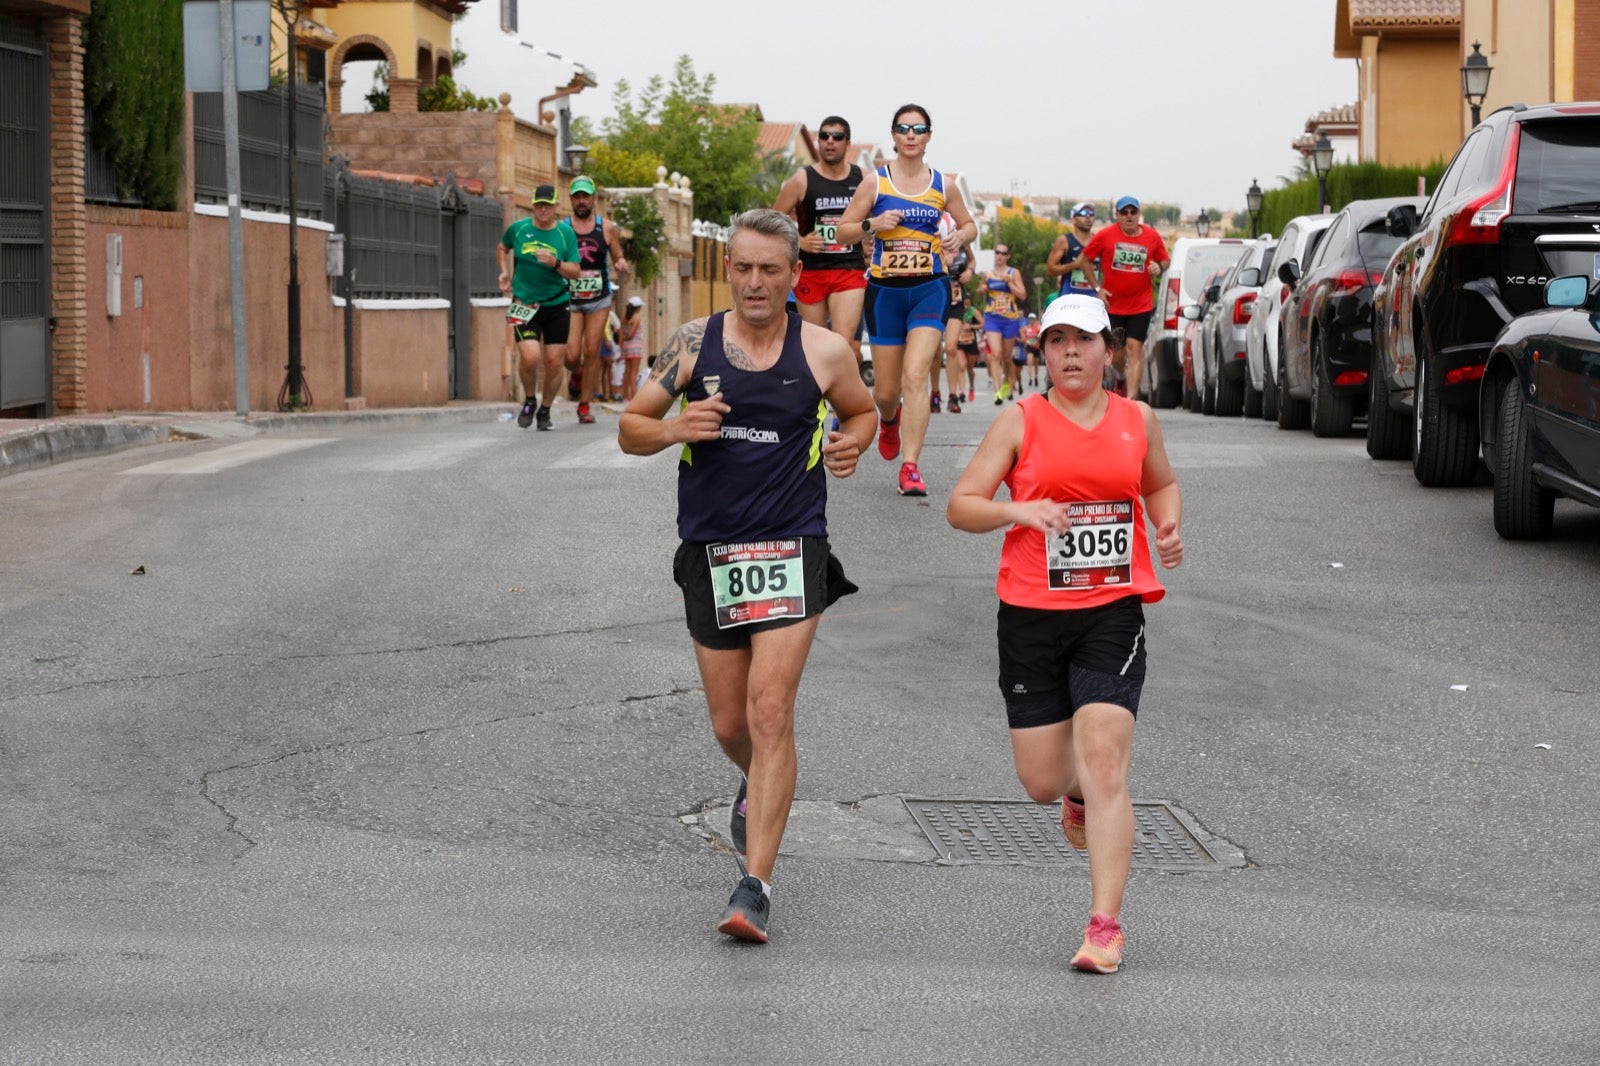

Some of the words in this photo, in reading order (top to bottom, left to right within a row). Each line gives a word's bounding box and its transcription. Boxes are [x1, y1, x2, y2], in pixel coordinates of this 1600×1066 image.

[818, 227, 836, 241] 10
[888, 254, 930, 269] 2212
[576, 279, 597, 290] 272
[1084, 504, 1106, 515] PREMIO
[727, 543, 743, 554] GRAN
[767, 540, 776, 551] DE
[776, 540, 796, 551] FONDO
[1058, 528, 1128, 559] 3056
[728, 563, 788, 598] 805
